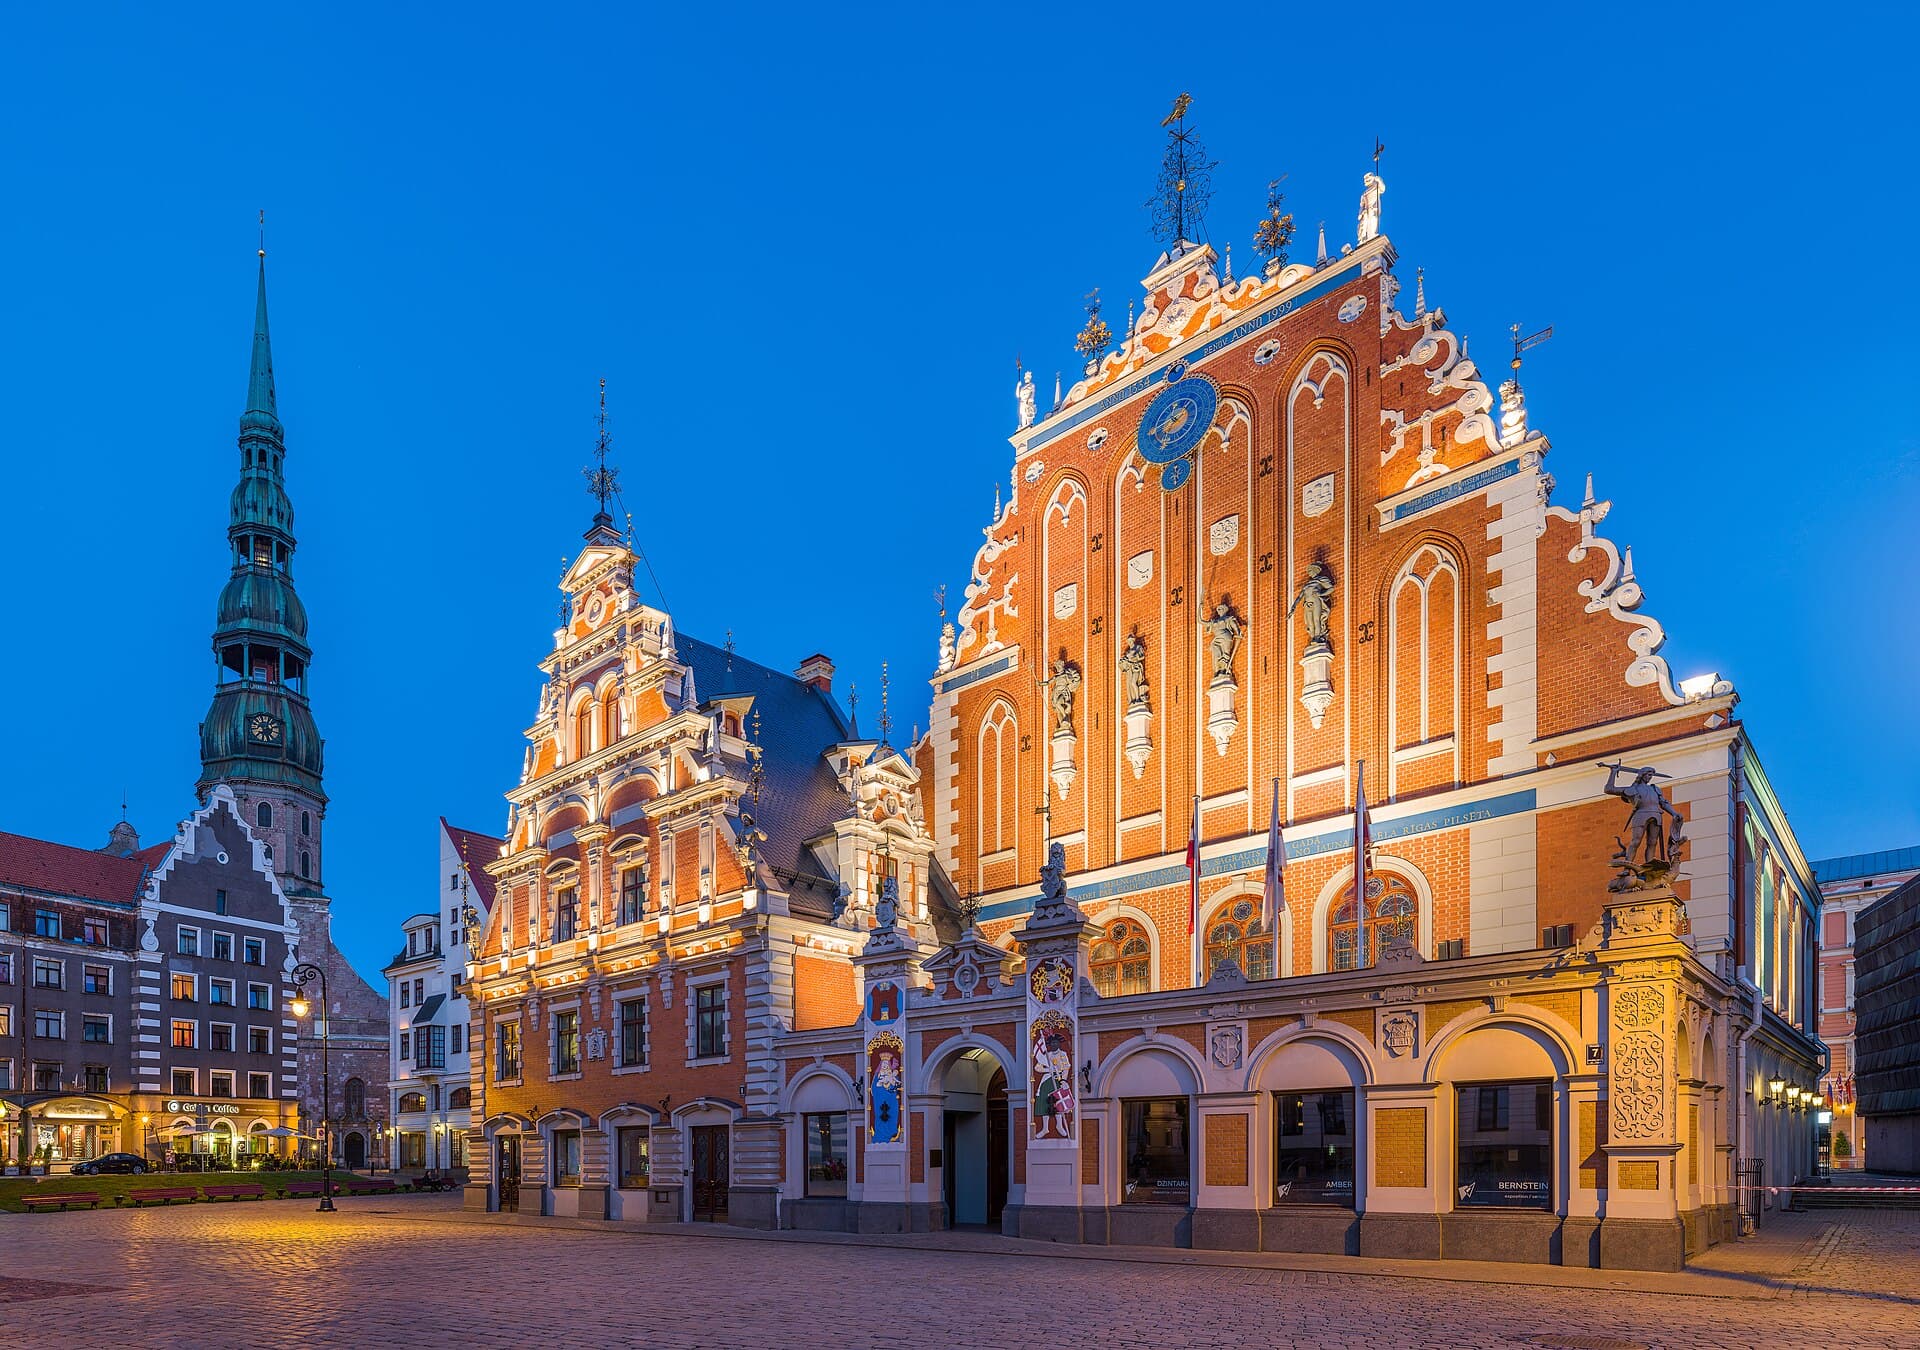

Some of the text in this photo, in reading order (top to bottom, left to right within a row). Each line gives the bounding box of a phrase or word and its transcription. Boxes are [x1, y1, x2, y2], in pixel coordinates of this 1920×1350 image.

[1231, 316, 1263, 341] ANNO
[1267, 300, 1293, 322] 1999
[1295, 847, 1311, 858] NO
[1592, 1048, 1599, 1058] 7
[212, 1103, 240, 1114] Coffee
[1498, 1181, 1549, 1190] BERNSTEIN
